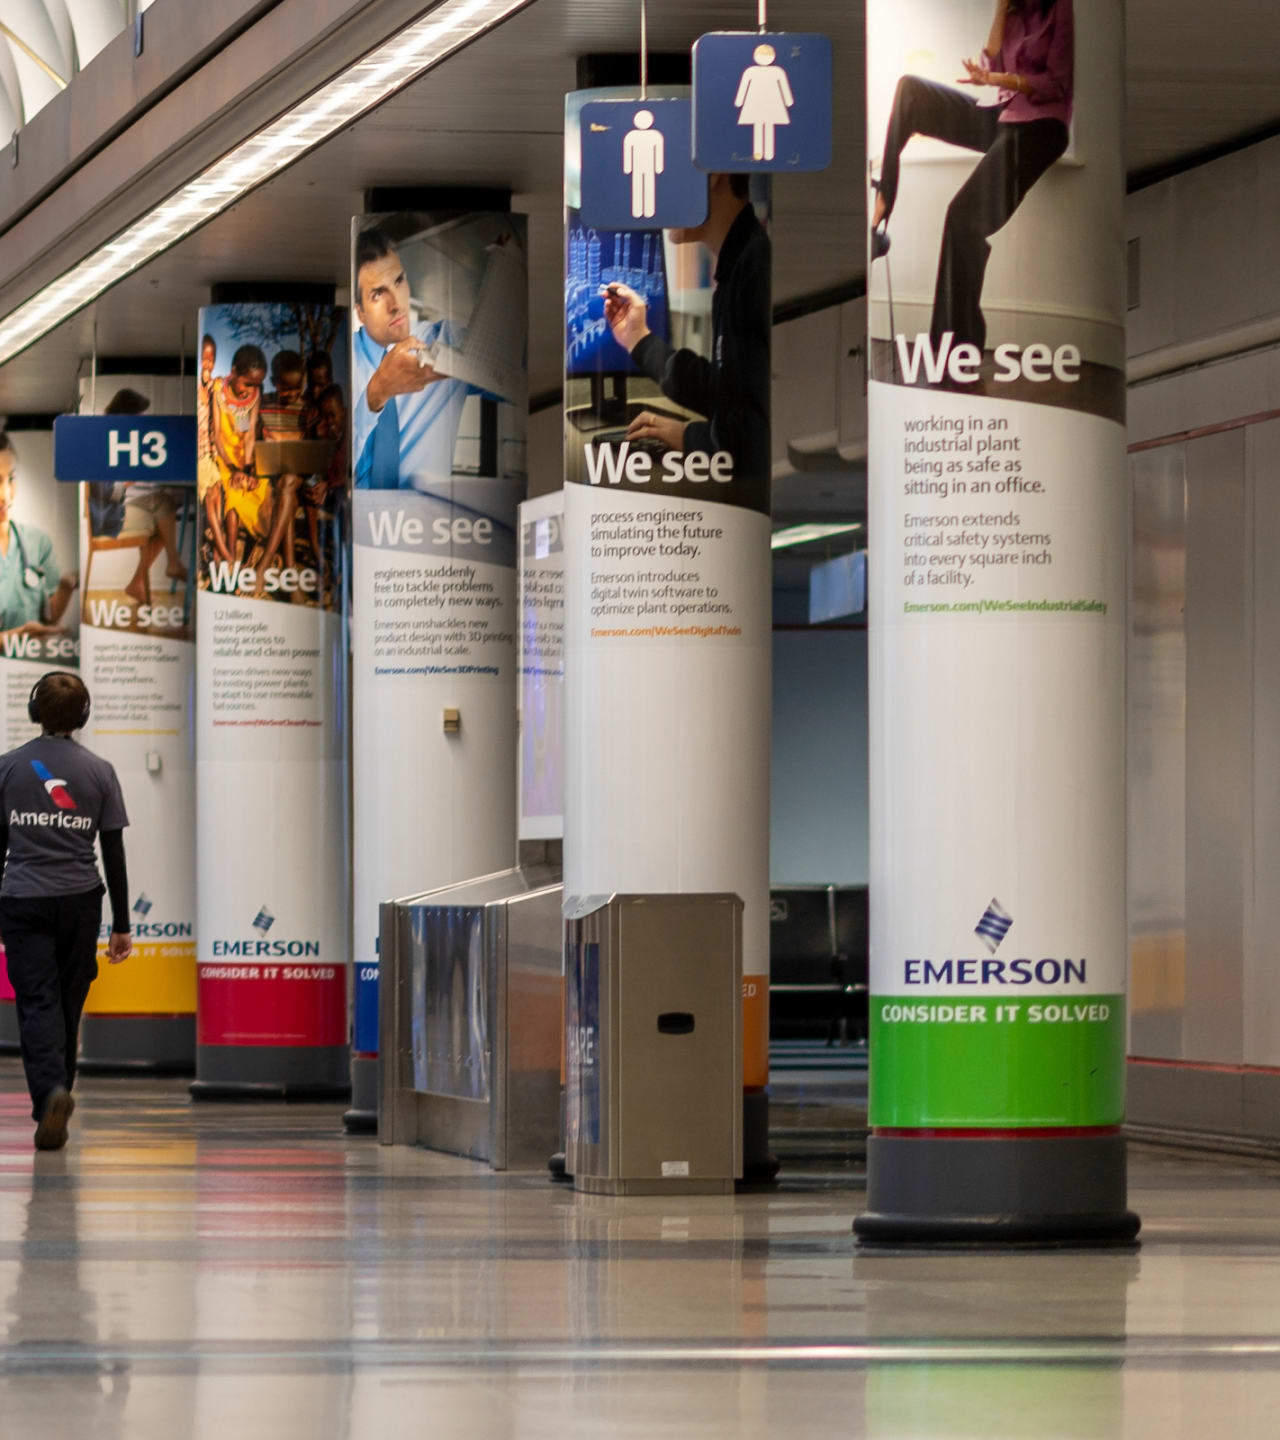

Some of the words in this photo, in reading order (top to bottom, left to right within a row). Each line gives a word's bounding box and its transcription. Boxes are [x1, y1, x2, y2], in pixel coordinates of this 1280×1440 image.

[896, 331, 981, 384] We
[993, 342, 1081, 383] see
[904, 415, 964, 435] working
[969, 415, 983, 431] in
[988, 418, 1008, 431] an
[108, 430, 167, 467] H3
[904, 436, 972, 453] industrial
[977, 435, 1021, 455] plant
[584, 441, 652, 484] We
[662, 449, 734, 483] see
[905, 459, 943, 477] being
[946, 461, 963, 473] as
[967, 456, 1000, 472] safe
[1004, 460, 1022, 472] as
[904, 480, 948, 498] sitting
[952, 479, 966, 493] in
[971, 481, 990, 493] an
[995, 477, 1045, 493] office.
[591, 512, 634, 525] process
[636, 509, 703, 525] engineers
[905, 513, 958, 527] Emerson
[962, 511, 1020, 526] extends
[368, 511, 424, 546] We
[432, 517, 493, 544] see
[591, 527, 654, 542] simulating
[657, 527, 680, 538] the
[683, 525, 723, 538] future
[904, 532, 943, 547] critical
[946, 530, 989, 549] safety
[992, 533, 1051, 549] systems
[591, 546, 601, 557] to
[604, 544, 656, 559] improve
[659, 542, 701, 558] today.
[904, 552, 926, 566] into
[929, 554, 965, 568] every
[969, 553, 1019, 568] square
[1022, 550, 1052, 564] inch
[209, 561, 257, 593] We
[264, 567, 317, 593] see
[374, 567, 422, 581] engineers
[424, 565, 475, 582] suddenly
[591, 572, 634, 584] Emerson
[637, 571, 699, 582] introduces
[904, 569, 916, 585] of
[918, 573, 924, 585] a
[927, 569, 974, 588] facility.
[393, 583, 404, 592] to
[406, 581, 439, 592] tackle
[443, 581, 493, 593] problems
[591, 587, 621, 602] digital
[623, 587, 648, 598] twin
[651, 586, 704, 598] software
[706, 587, 718, 597] to
[374, 597, 382, 607] in
[384, 595, 446, 609] completely
[449, 597, 473, 606] new
[475, 598, 503, 609] ways.
[591, 604, 635, 618] optimize
[637, 603, 667, 616] plant
[670, 603, 733, 615] operations.
[904, 599, 1108, 615] Emerson.com/WeSeeIndustrialSafety
[90, 600, 131, 627] We
[137, 605, 184, 627] see
[374, 620, 410, 629] Emerson
[469, 621, 488, 629] new
[3, 633, 40, 658] We
[409, 632, 442, 645] design
[444, 632, 465, 641] with
[469, 632, 481, 641] 3D
[398, 646, 442, 655] industrial
[9, 809, 92, 830] American
[213, 941, 319, 956] EMERSON
[201, 968, 259, 979] CONSIDER
[263, 968, 278, 979] IT
[282, 968, 335, 980] SOLVED
[904, 959, 1087, 985] EMERSON
[881, 1005, 986, 1023] CONSIDER
[995, 1005, 1020, 1023] IT
[1028, 1005, 1110, 1023] SOLVED
